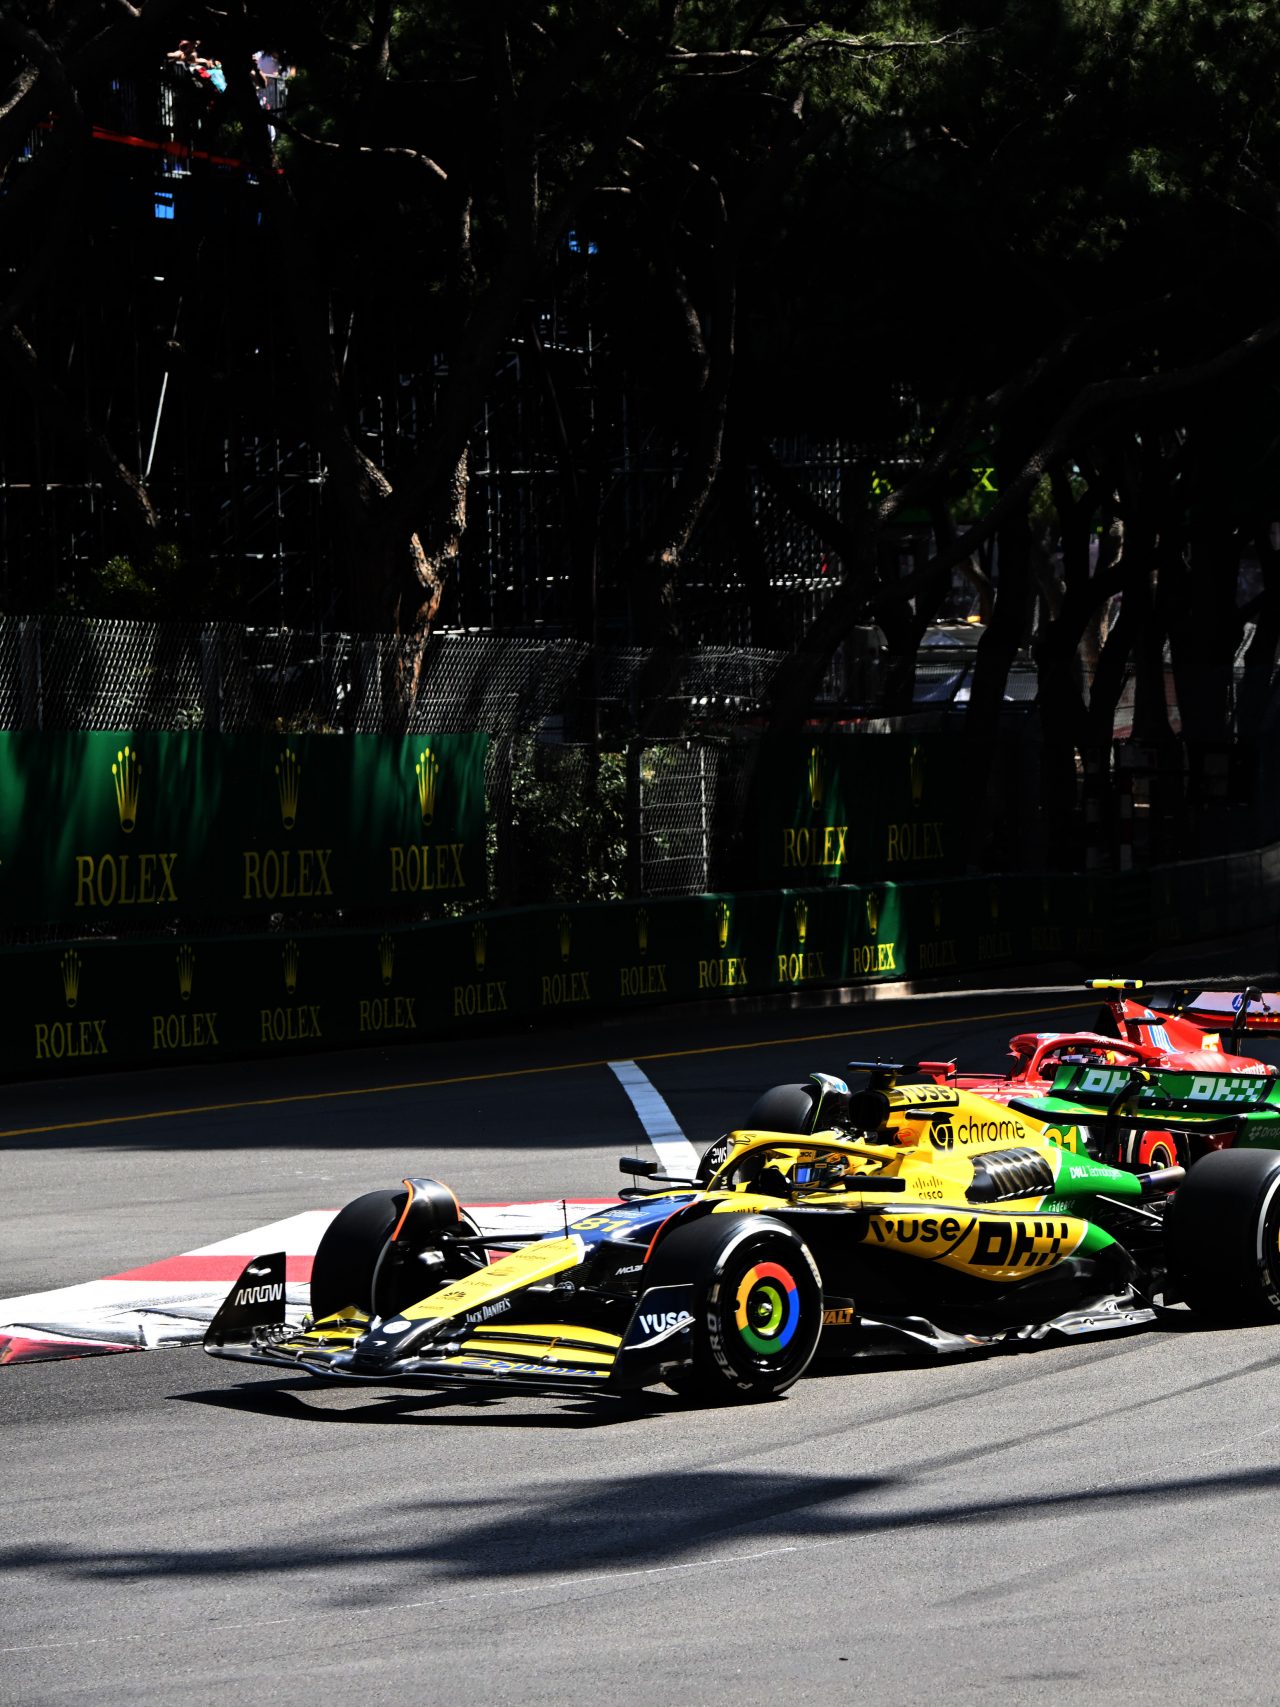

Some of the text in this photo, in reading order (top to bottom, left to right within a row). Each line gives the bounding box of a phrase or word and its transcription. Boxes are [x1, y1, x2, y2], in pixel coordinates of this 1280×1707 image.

[783, 826, 849, 868] ROLEX
[887, 822, 945, 863] ROLEX
[75, 853, 178, 907] ROLEX
[243, 849, 333, 900] ROLEX
[390, 844, 466, 893] ROLEX
[698, 956, 748, 988] ROLEX
[778, 951, 826, 983] ROLEX
[850, 942, 896, 973] ROLEX
[541, 971, 592, 1006] ROLEX
[619, 963, 668, 997] ROLEX
[359, 997, 417, 1032] ROLEX
[452, 980, 508, 1017] ROLEX
[34, 1019, 109, 1060] ROLEX
[151, 1012, 220, 1050] ROLEX
[260, 1004, 323, 1042] ROLEX
[1190, 1077, 1265, 1101] OKX
[958, 1116, 1026, 1145] chrome
[570, 1217, 631, 1232] 81
[870, 1217, 960, 1244] vuse
[968, 1221, 1069, 1266] OKX
